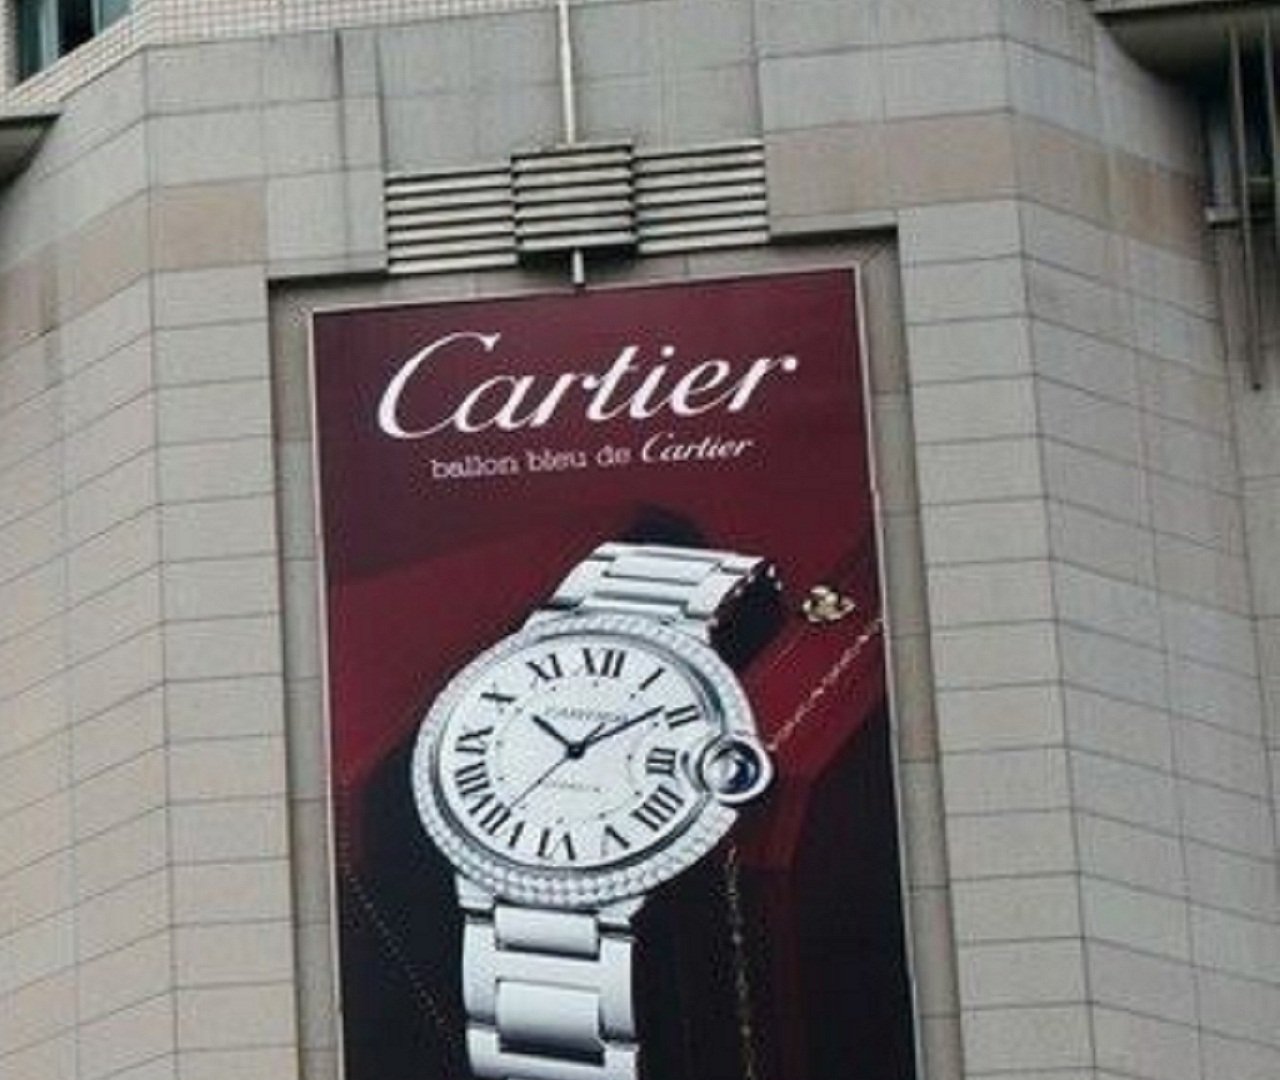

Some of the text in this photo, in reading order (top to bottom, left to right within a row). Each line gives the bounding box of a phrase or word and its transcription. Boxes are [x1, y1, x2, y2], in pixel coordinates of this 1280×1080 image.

[377, 331, 799, 440] Cartier
[432, 431, 755, 479] ballon bleu de Cartier
